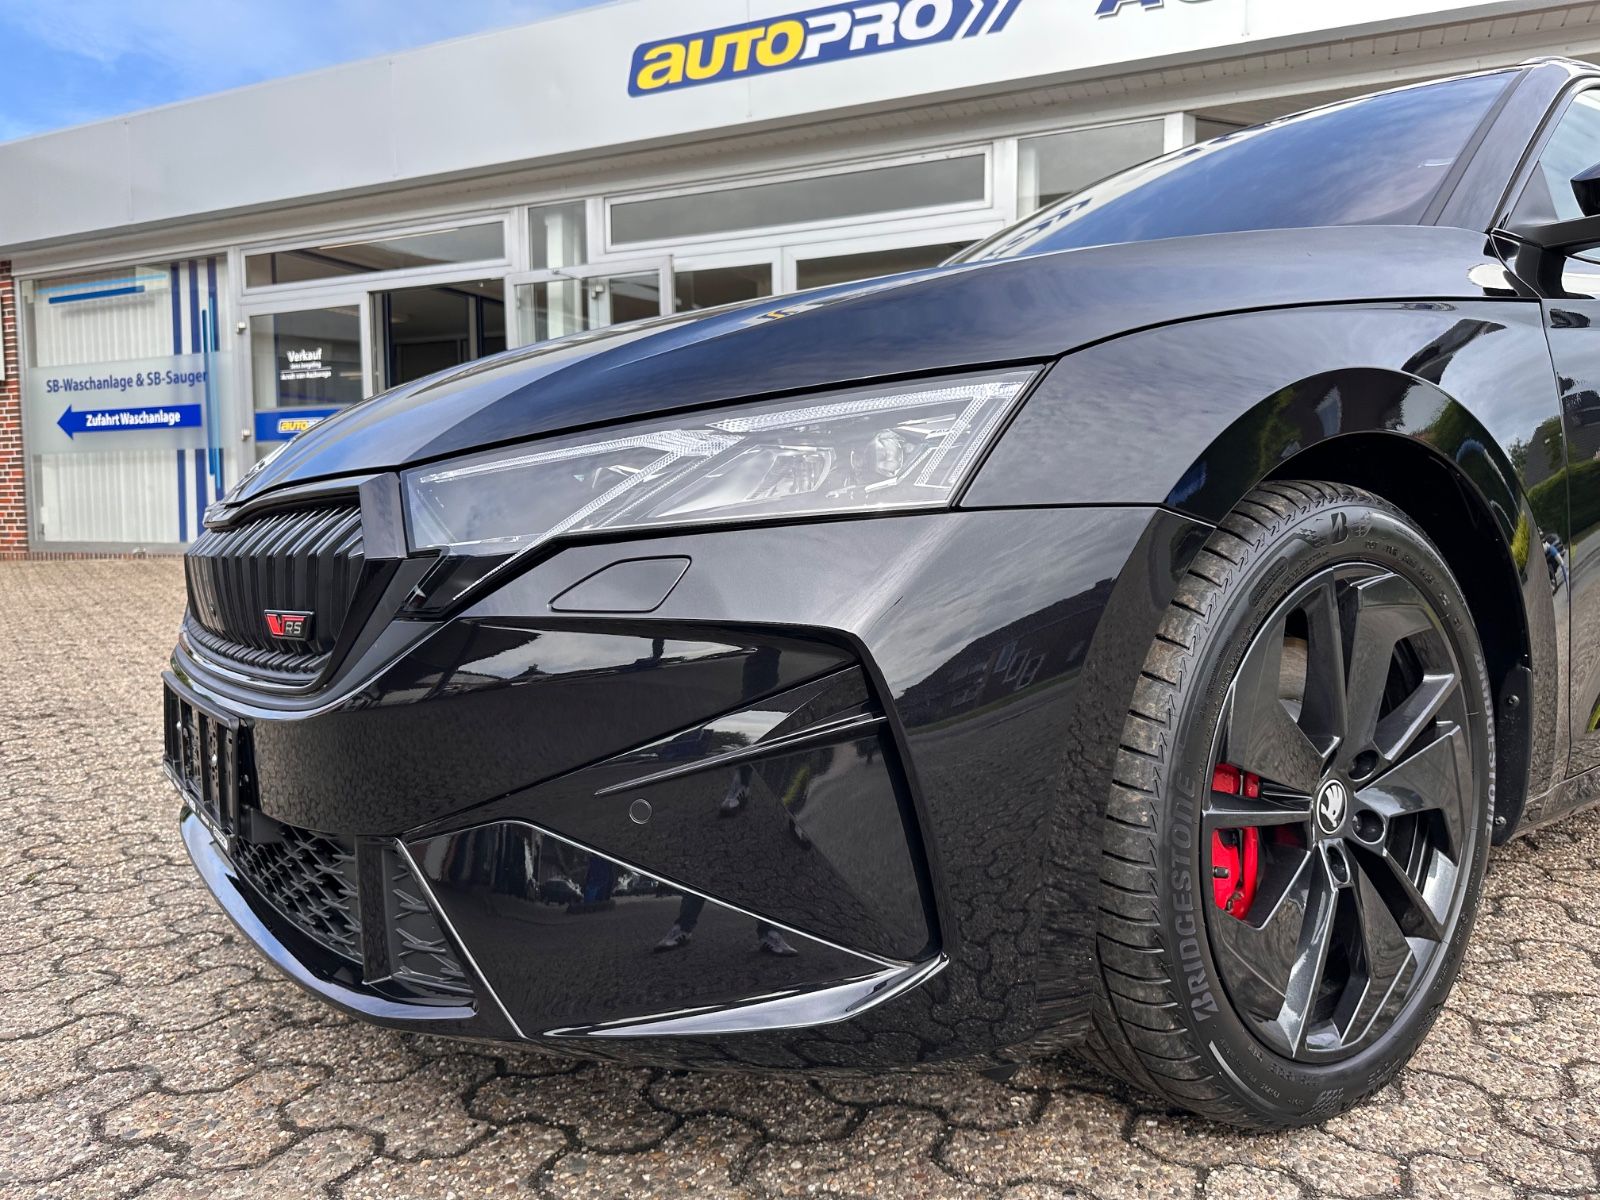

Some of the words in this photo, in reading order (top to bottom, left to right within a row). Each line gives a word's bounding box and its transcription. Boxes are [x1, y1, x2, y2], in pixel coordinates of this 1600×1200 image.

[287, 347, 322, 362] Verkauf
[46, 374, 133, 393] SB-Waschanlage
[136, 372, 144, 387] &
[147, 370, 208, 387] SB-Sauger
[86, 412, 120, 427] Zufahrt
[120, 409, 181, 426] Waschanlage
[1474, 653, 1497, 837] BRIDGESTONE
[1171, 770, 1219, 1022] BRIDGESTONE
